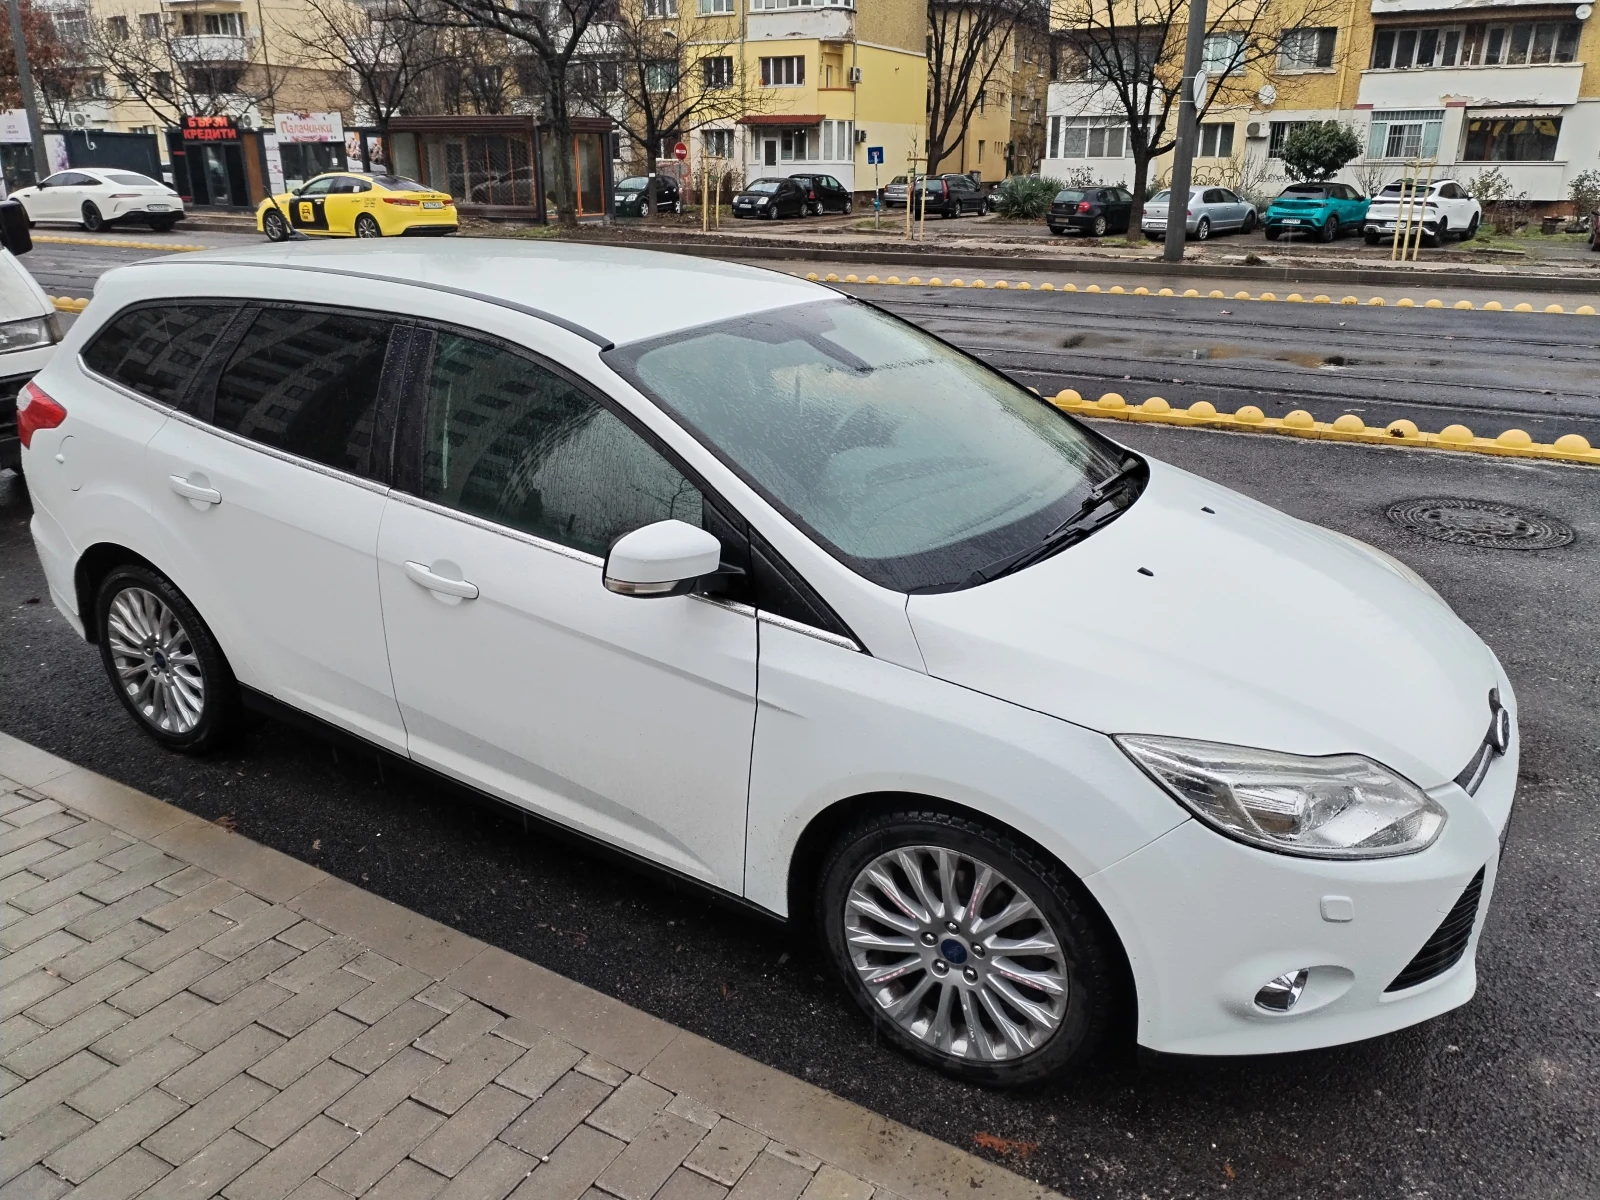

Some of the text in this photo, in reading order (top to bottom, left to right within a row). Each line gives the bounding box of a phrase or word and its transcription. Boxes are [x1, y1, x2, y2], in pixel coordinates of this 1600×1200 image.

[187, 116, 229, 128] БЪРЗИ
[280, 121, 333, 134] Палачинки
[183, 128, 237, 140] КРЕДИТИ
